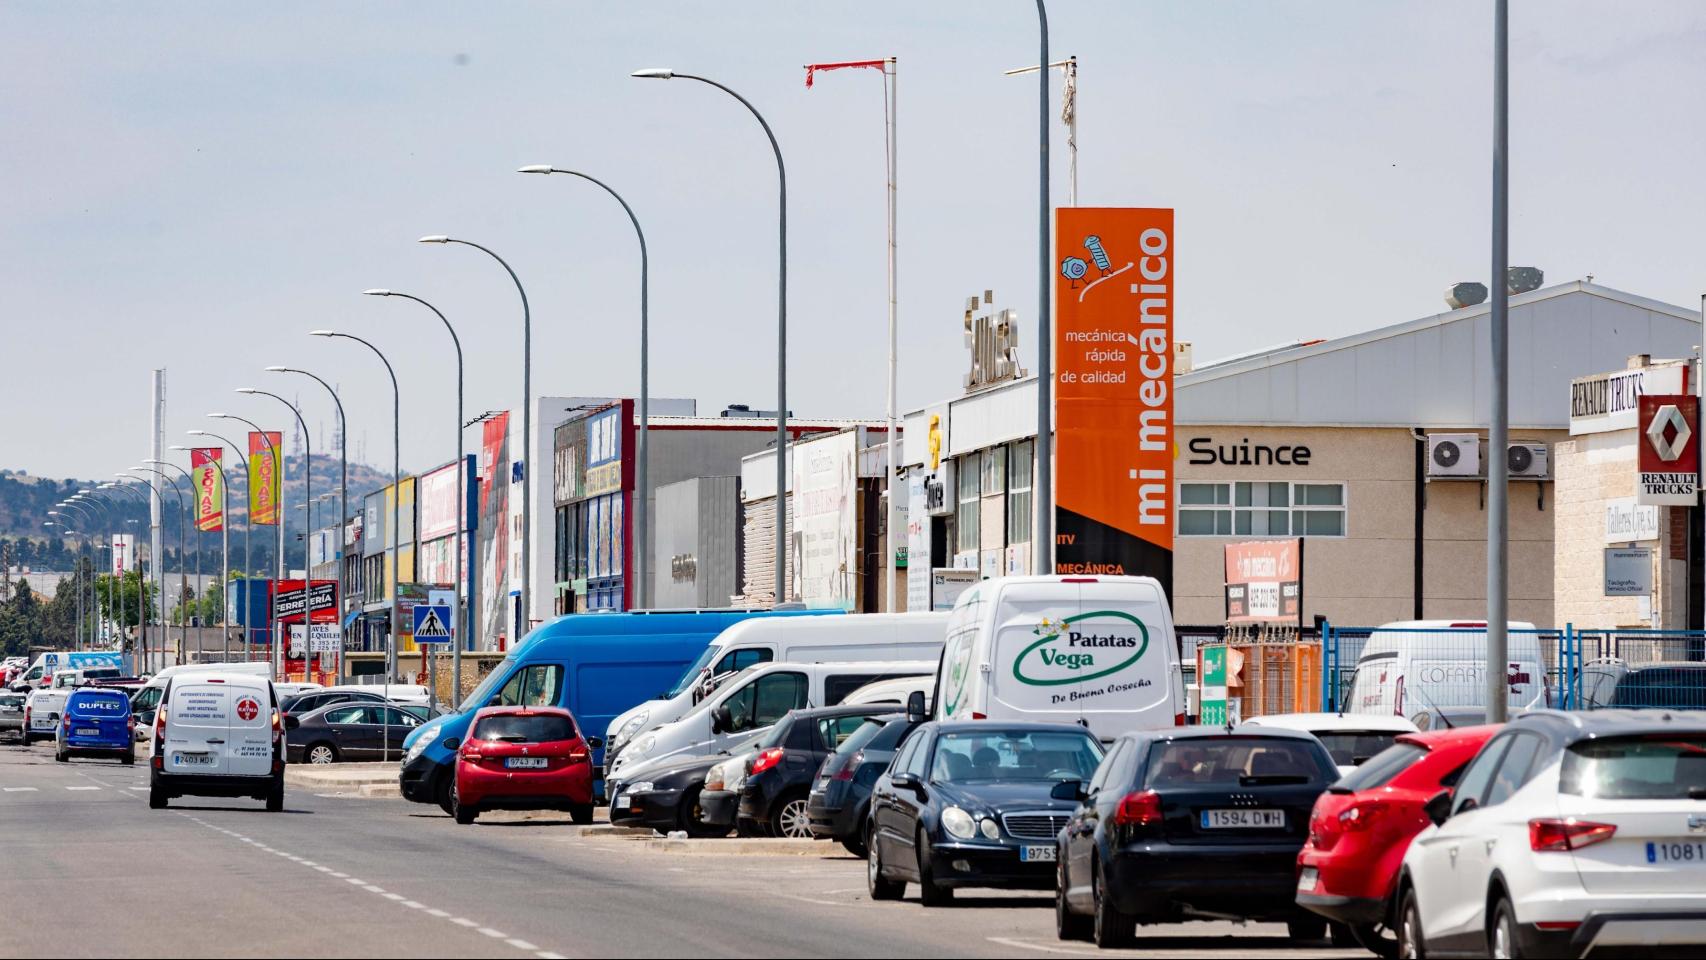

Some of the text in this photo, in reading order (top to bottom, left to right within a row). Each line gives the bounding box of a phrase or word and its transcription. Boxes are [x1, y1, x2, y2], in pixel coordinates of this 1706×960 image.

[1066, 328, 1126, 342] mecánica
[1085, 348, 1126, 365] rápida
[1060, 370, 1126, 384] de calidad
[1127, 228, 1167, 525] mi mecánico
[1572, 372, 1644, 418] RENAULT TRUCKS
[1188, 438, 1312, 466] Suince
[1641, 474, 1696, 484] RENAULT
[1644, 484, 1693, 494] TRUCKS
[1056, 534, 1076, 545] ITV
[1056, 561, 1124, 575] MECÁNICA
[276, 594, 332, 612] FERREERÍA
[1068, 632, 1136, 648] Patatas
[1039, 649, 1094, 670] Vega
[1420, 667, 1488, 683] COFART
[1051, 680, 1152, 704] De Buena Cosecha
[1214, 811, 1281, 825] 1594 DWH
[1661, 844, 1704, 860] 1081
